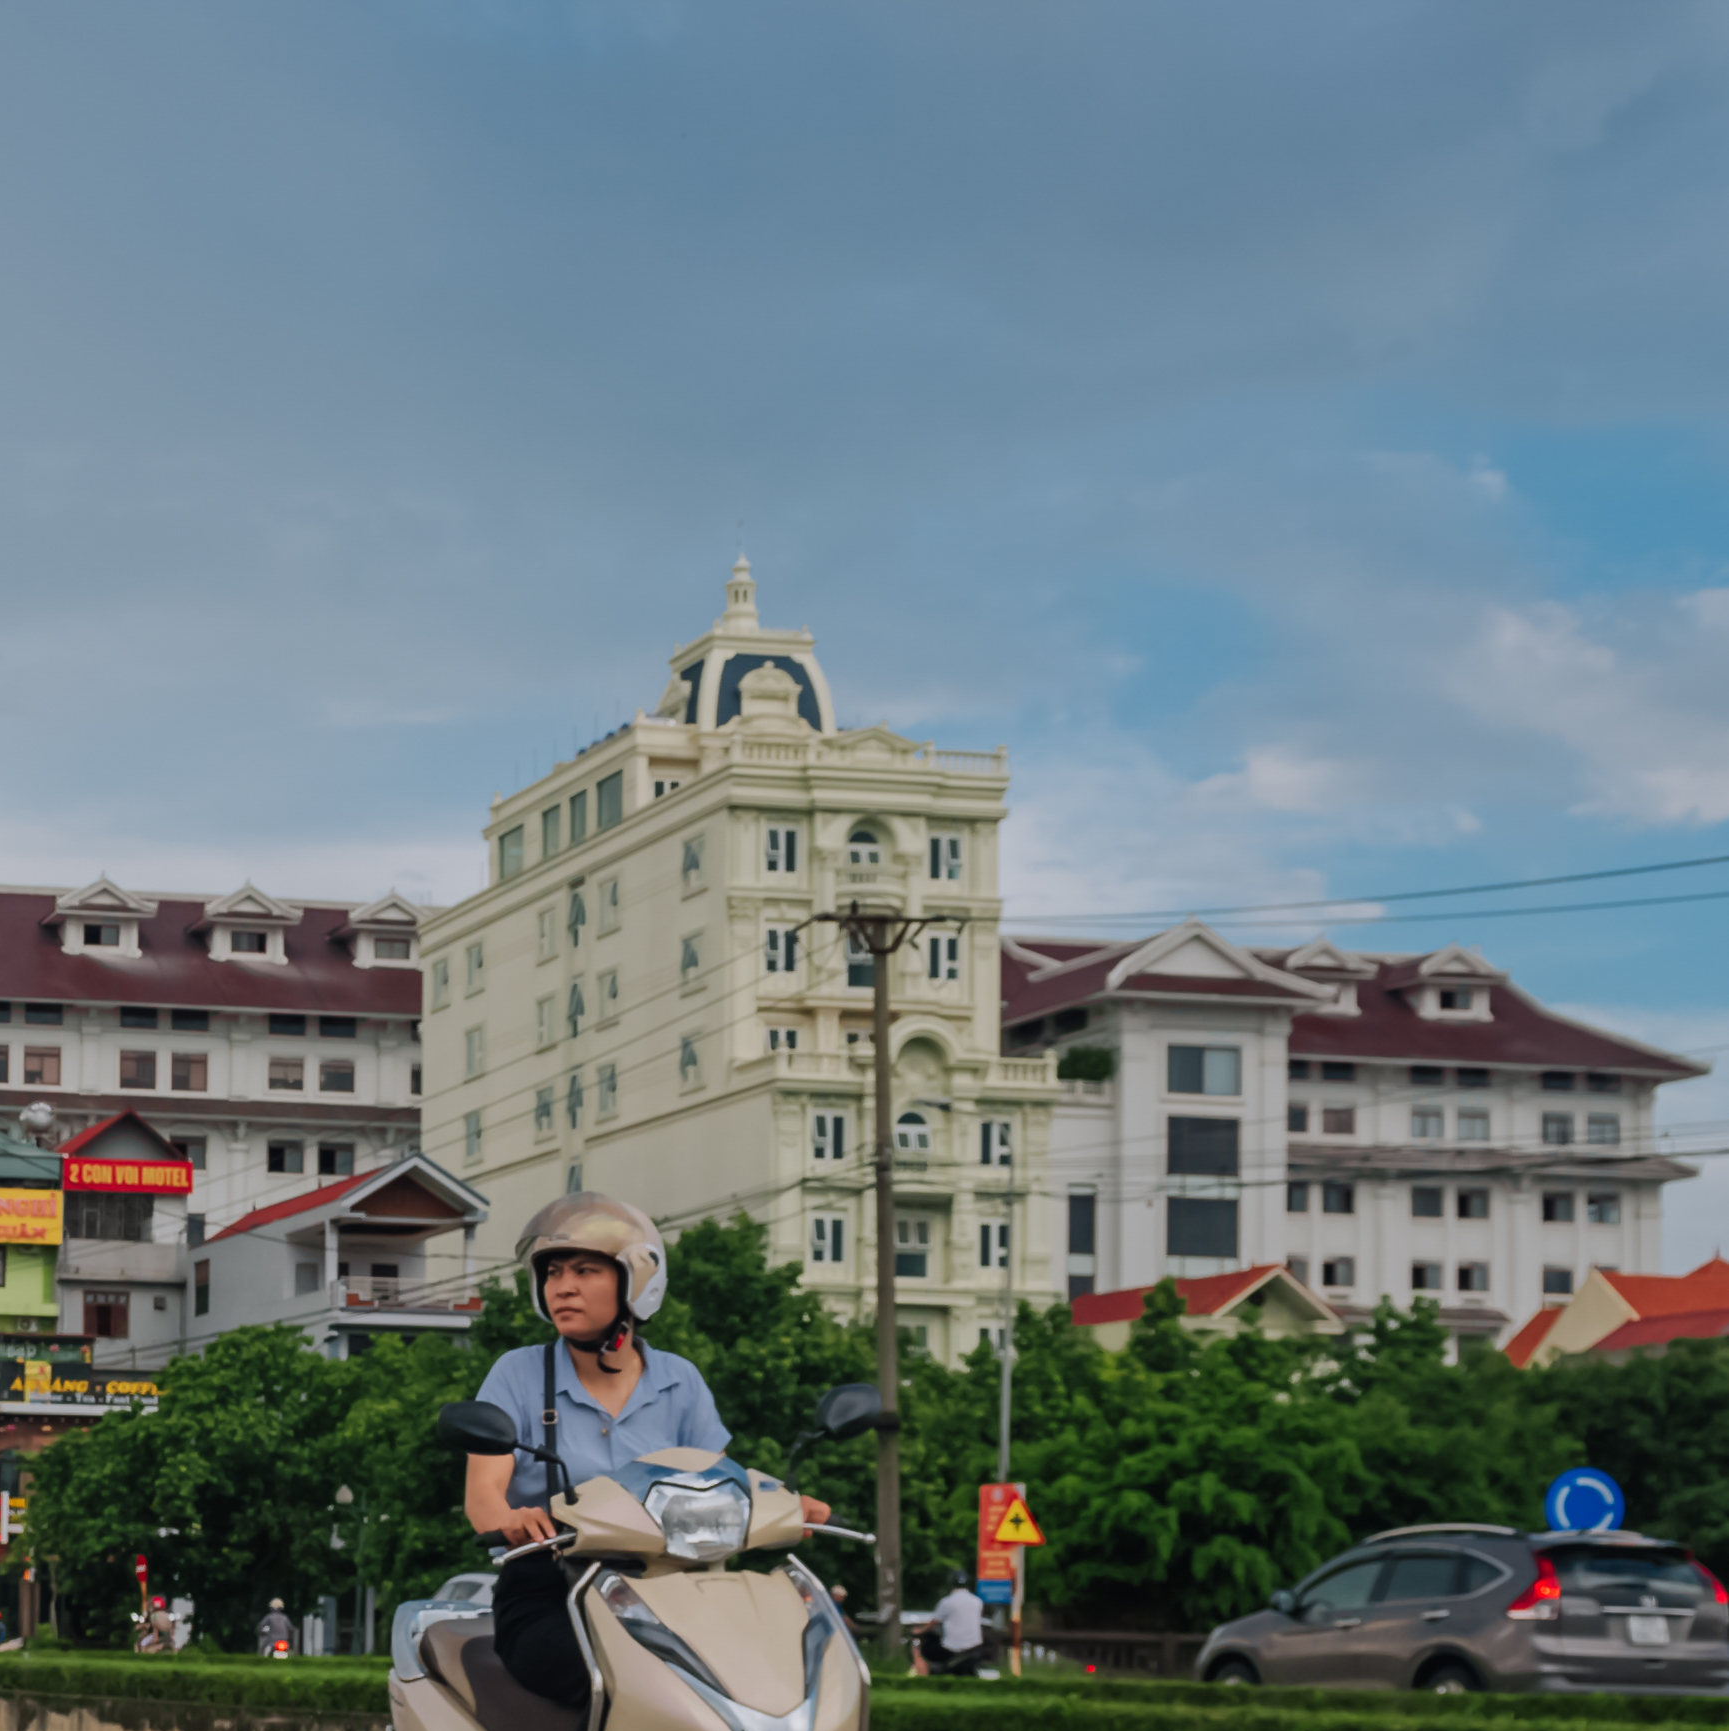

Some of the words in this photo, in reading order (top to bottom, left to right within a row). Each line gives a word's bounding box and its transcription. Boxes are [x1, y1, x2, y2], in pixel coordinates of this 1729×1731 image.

[69, 1164, 80, 1183] 2
[82, 1164, 112, 1184] CON
[115, 1165, 139, 1185] VOI
[142, 1166, 189, 1188] MOTEL
